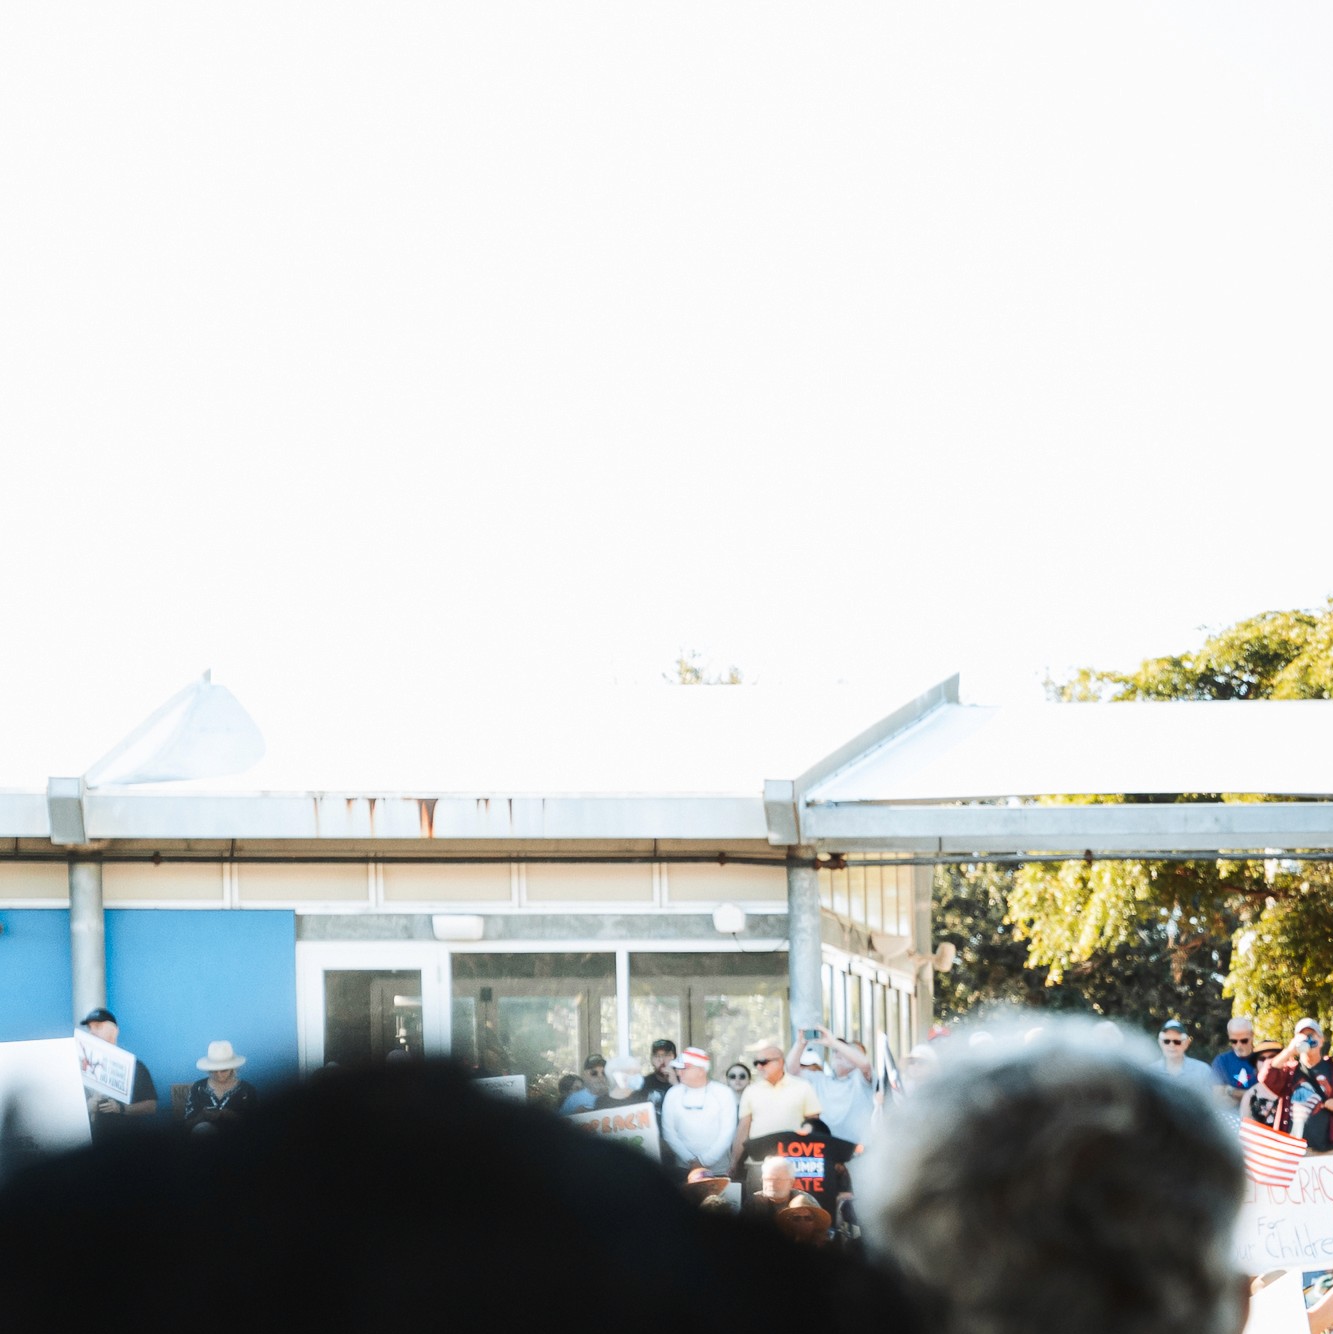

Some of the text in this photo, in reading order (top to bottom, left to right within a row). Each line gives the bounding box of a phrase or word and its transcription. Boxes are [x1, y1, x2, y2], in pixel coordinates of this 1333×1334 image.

[777, 1141, 826, 1158] LOVE
[793, 1160, 825, 1174] UMPS
[792, 1177, 824, 1192] ATE
